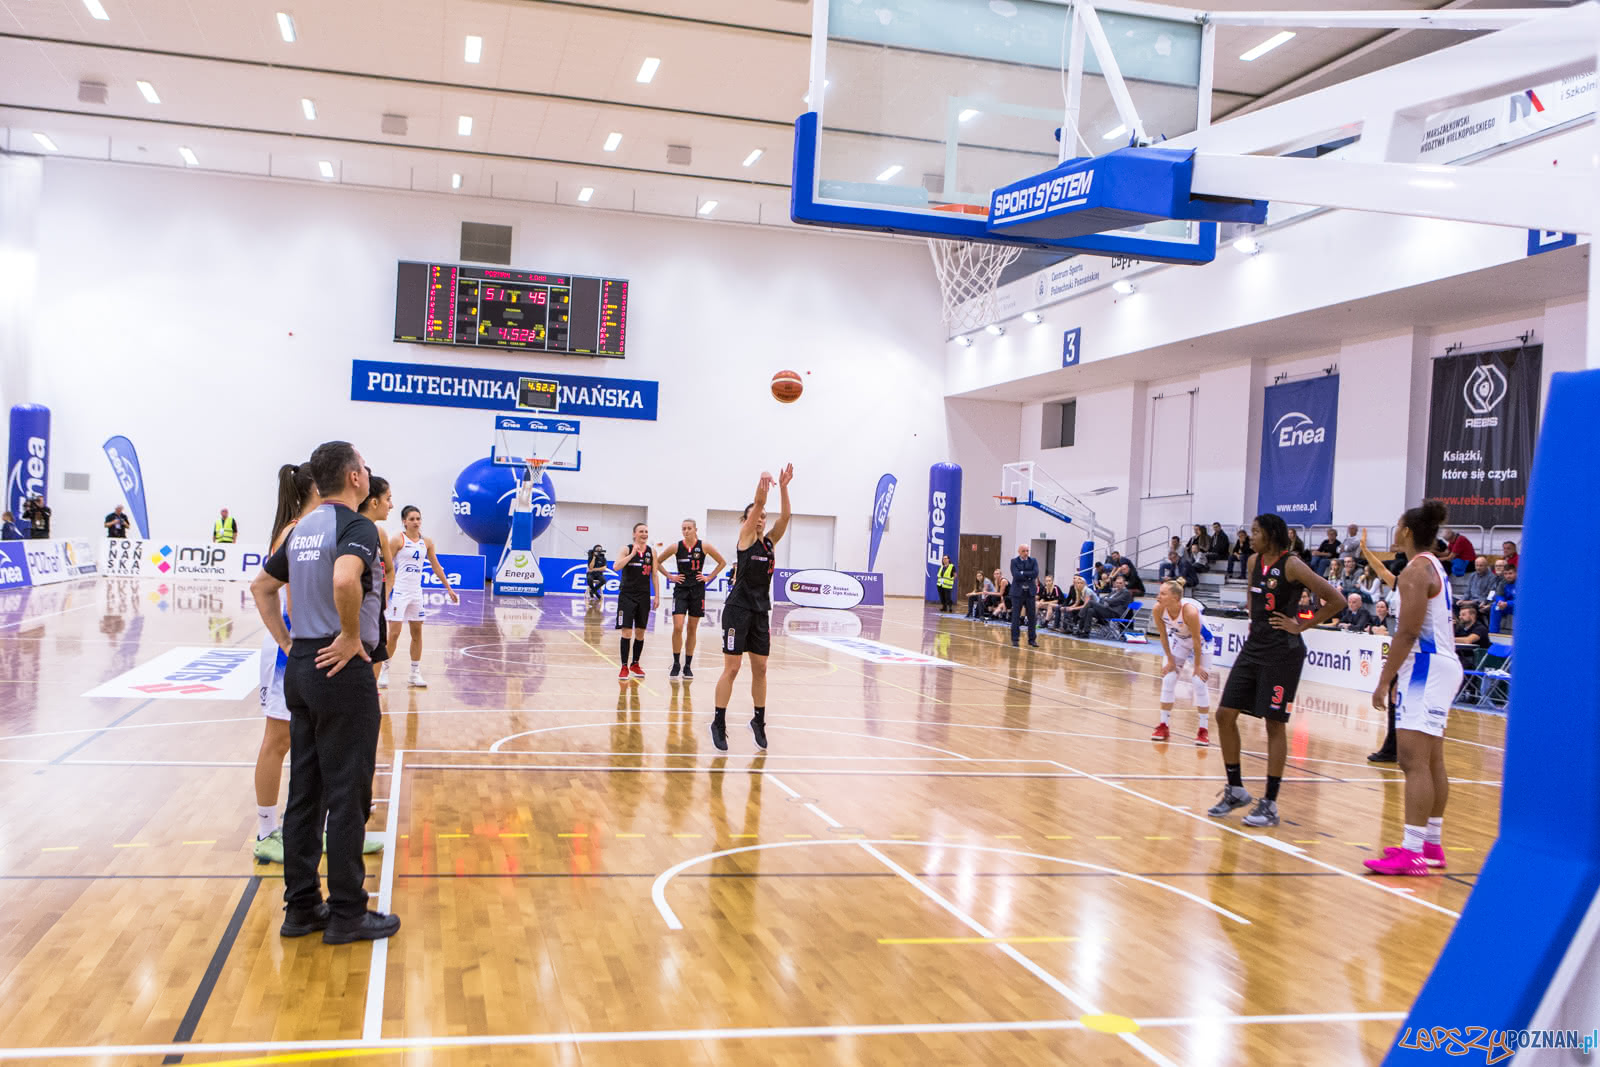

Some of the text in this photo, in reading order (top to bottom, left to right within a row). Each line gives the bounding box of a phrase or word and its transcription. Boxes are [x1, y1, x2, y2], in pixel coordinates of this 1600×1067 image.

[528, 291, 546, 305] 45
[1065, 331, 1076, 363] 3
[367, 371, 516, 400] POLITECHNIKA
[1465, 417, 1498, 429] REBIS
[1278, 425, 1325, 448] Enea
[1443, 450, 1483, 464] Książki,
[1441, 468, 1518, 482] które się czyta
[878, 482, 895, 526] Enea
[1276, 500, 1318, 513] www.enea.pl
[927, 490, 947, 567] Enea
[179, 547, 226, 567] mjp
[412, 550, 420, 560] 4
[177, 564, 225, 575] drukarnia
[691, 559, 700, 571] 11
[505, 570, 535, 580] Energa
[1264, 592, 1275, 611] 3
[1306, 650, 1351, 671] oznań
[1272, 685, 1284, 704] 3
